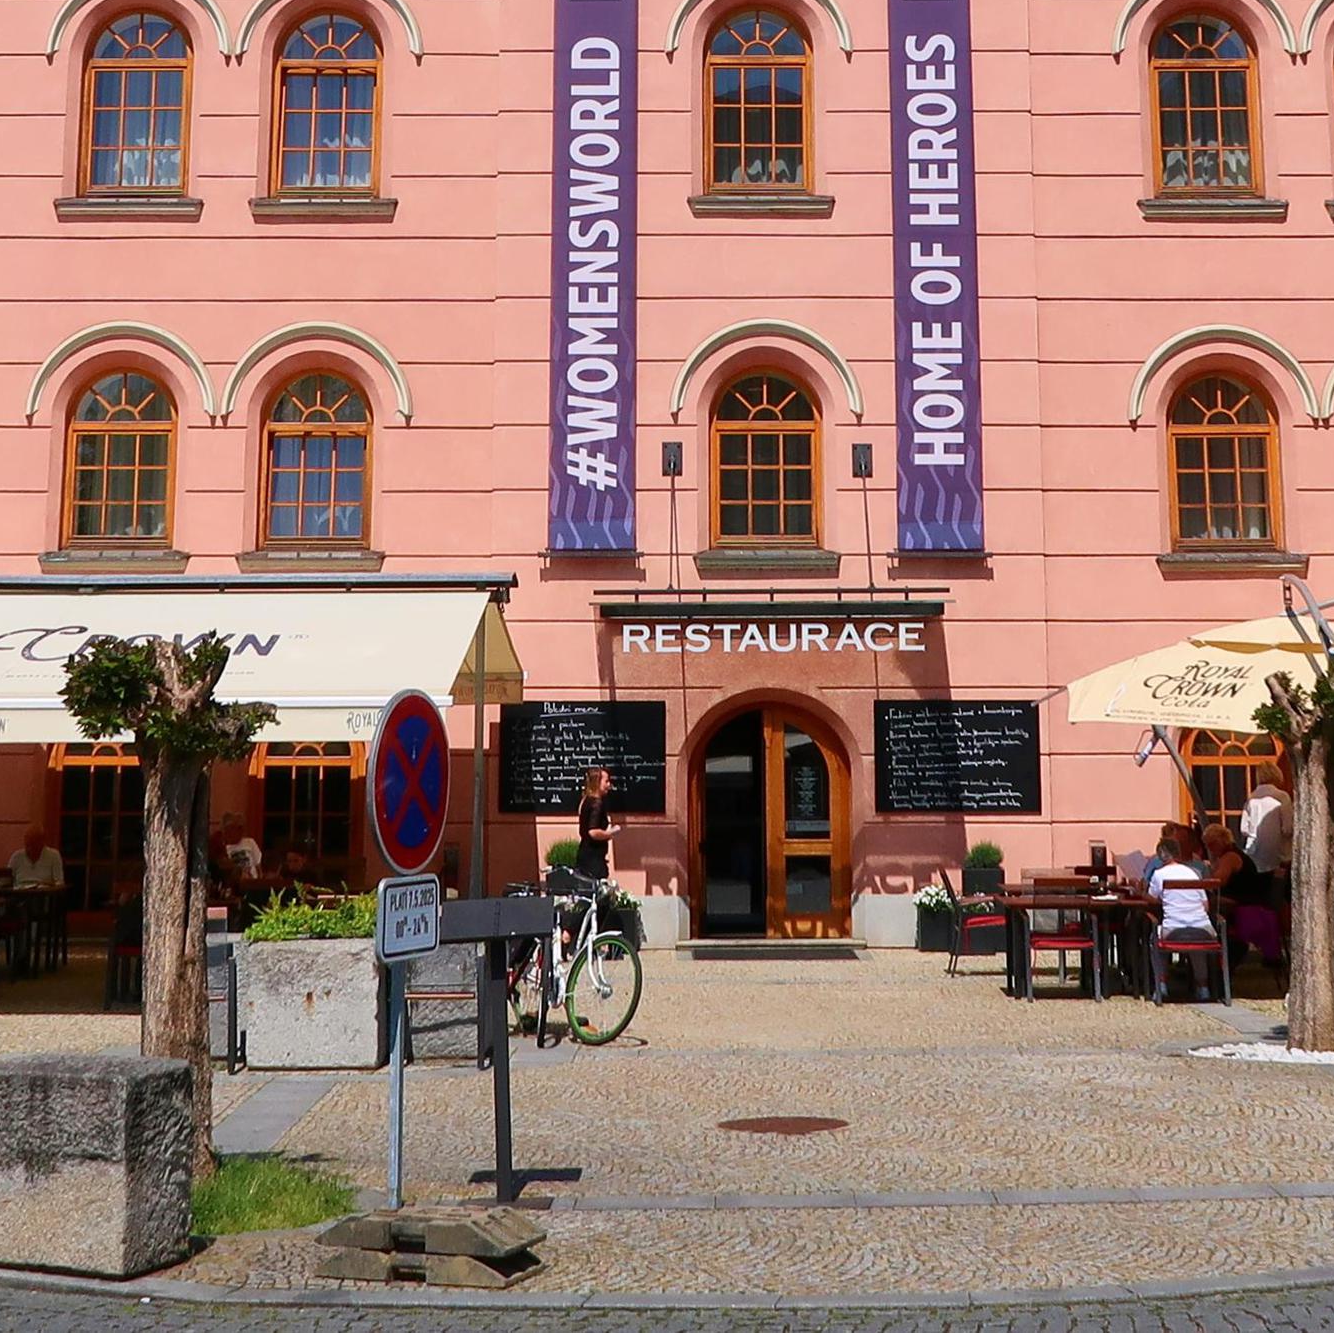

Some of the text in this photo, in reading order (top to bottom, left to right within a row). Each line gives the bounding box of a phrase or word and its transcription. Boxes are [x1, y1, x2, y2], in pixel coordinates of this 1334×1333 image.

[566, 36, 621, 491] #WOMENSWORLD
[904, 33, 966, 467] HOME OF HEROES
[622, 622, 926, 653] RESTAURACE
[1183, 660, 1255, 681] ROYAL
[1143, 674, 1246, 700] CROWN
[347, 711, 378, 735] ROYAL
